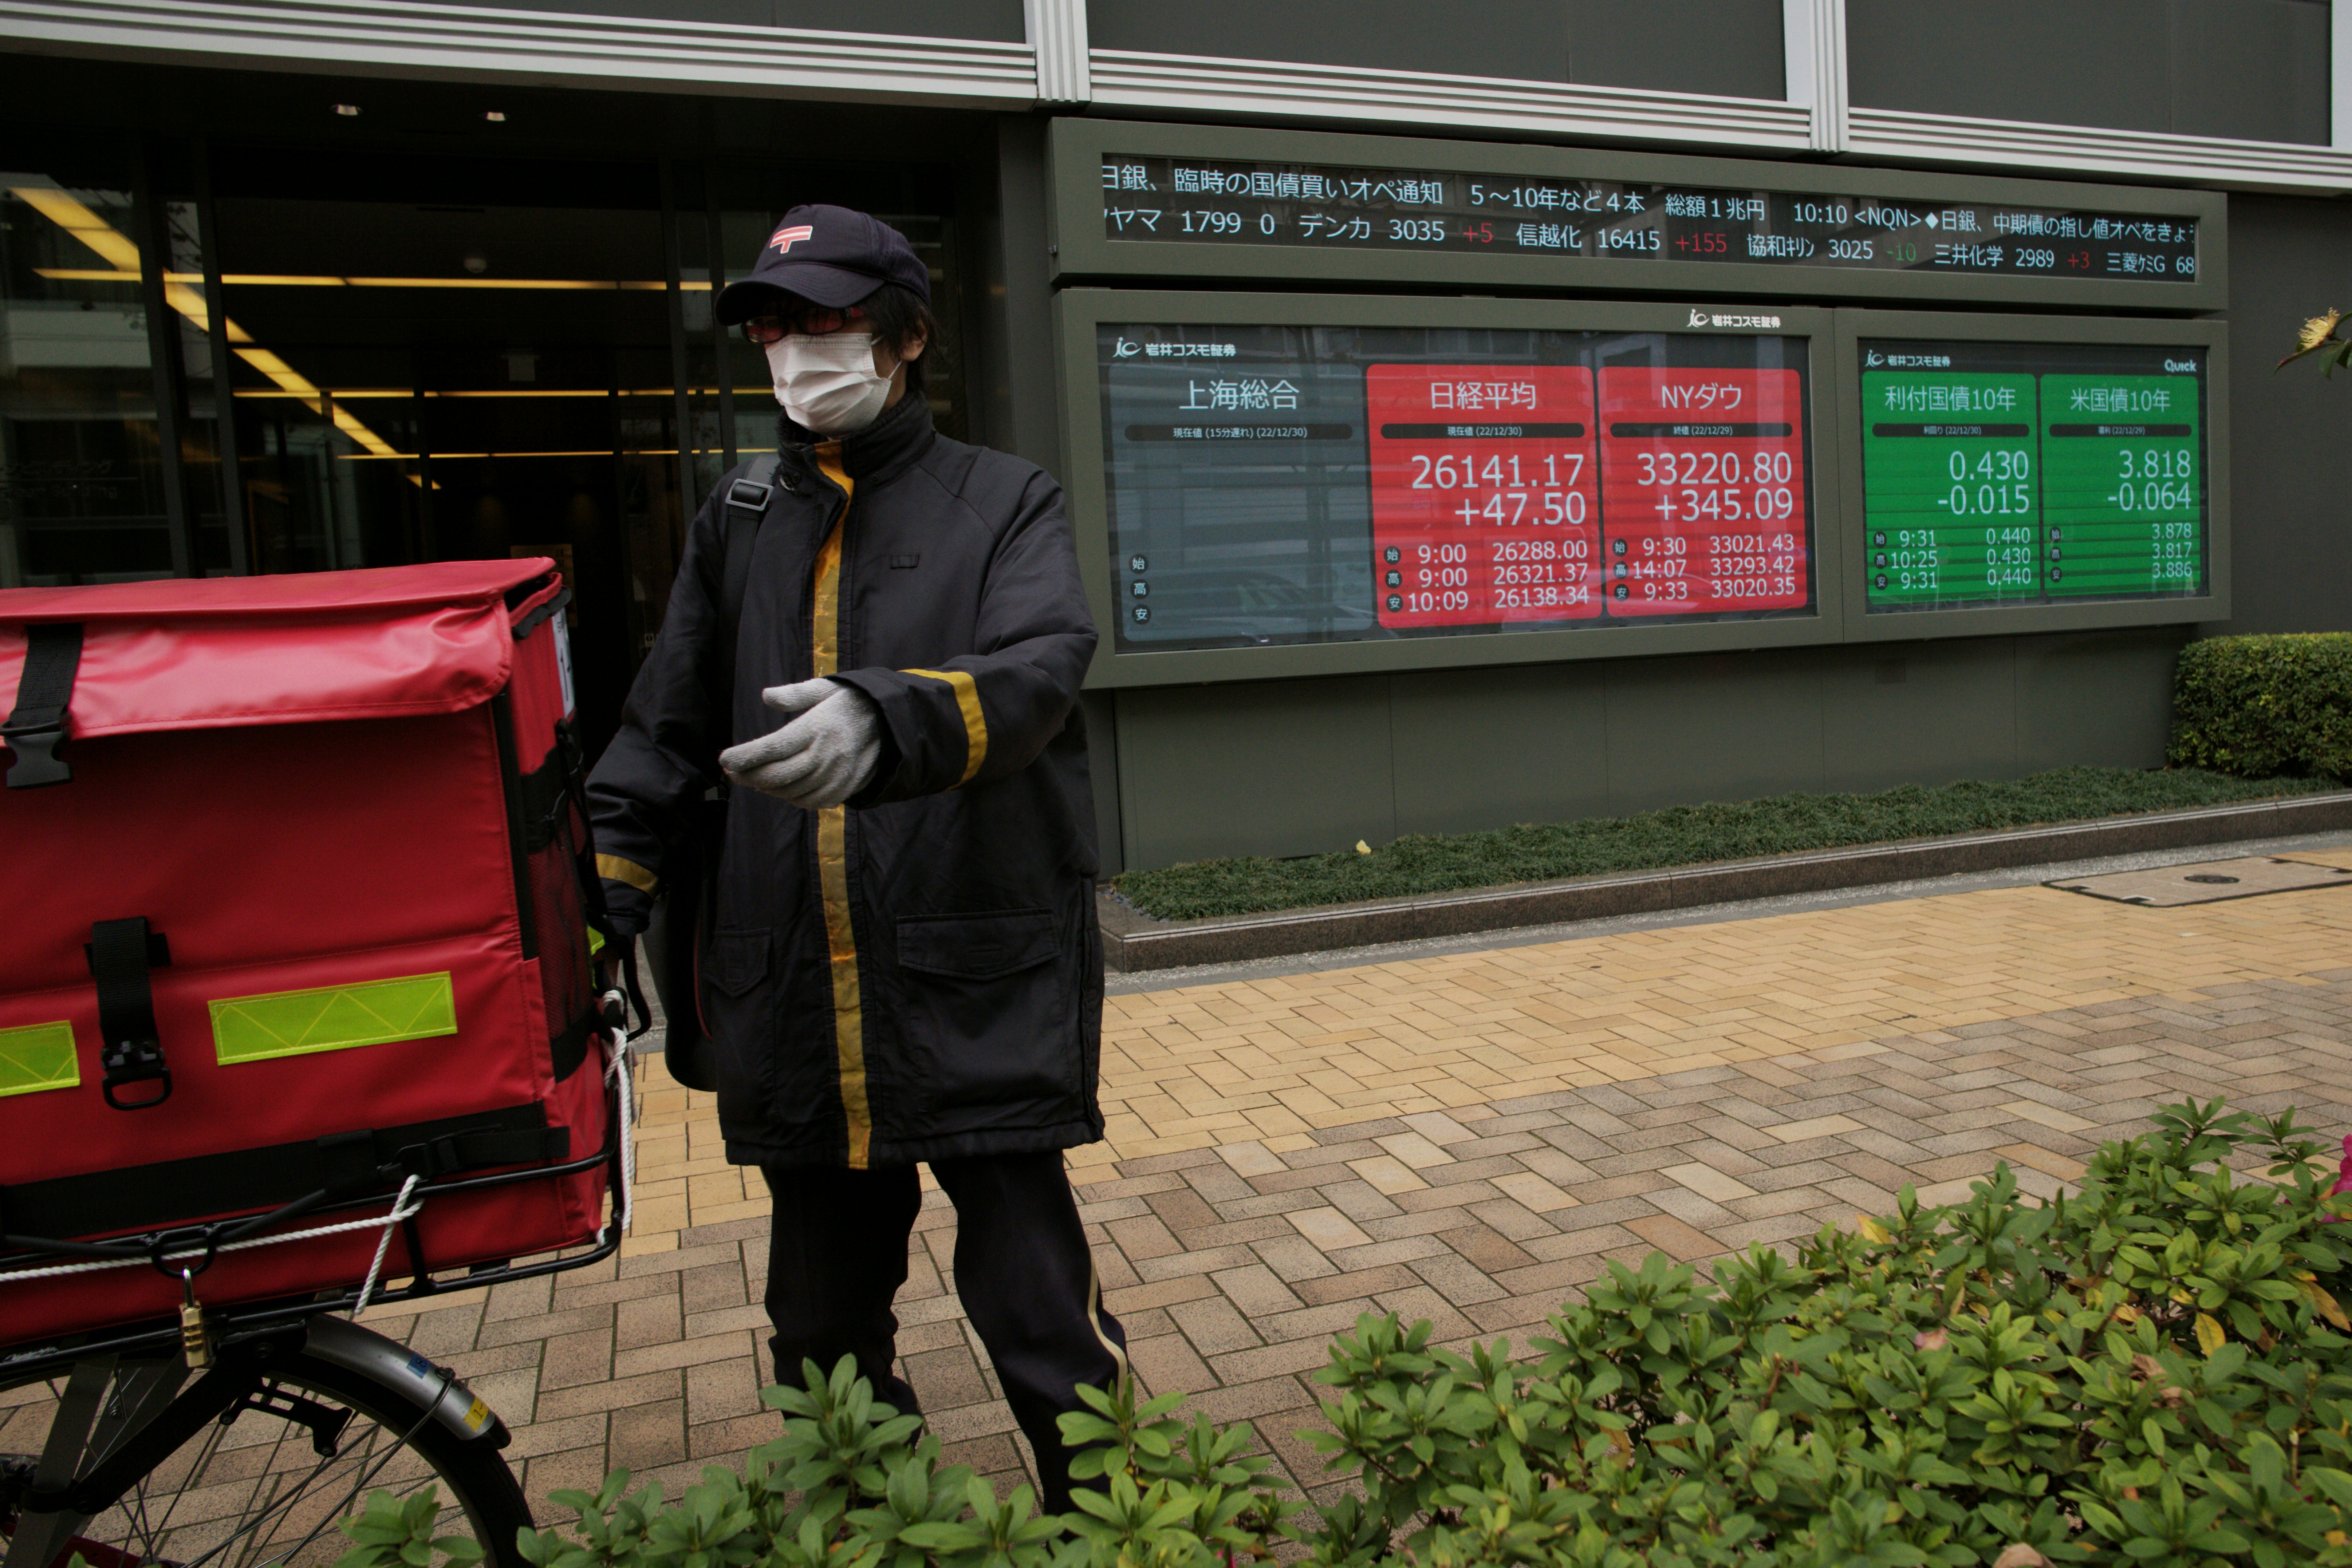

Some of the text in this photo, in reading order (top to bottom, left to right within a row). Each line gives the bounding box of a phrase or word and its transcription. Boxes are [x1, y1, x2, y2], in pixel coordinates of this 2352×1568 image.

[1794, 203, 1848, 224] 10:10
[1941, 210, 2194, 243] 日銀、中期債の指し値オペをきょ
[1104, 206, 1162, 232] ヤマ
[1181, 210, 1241, 233] 1799
[1260, 213, 1275, 234] 0
[1299, 213, 1370, 238] デンカ
[1390, 219, 1445, 241] 3035
[1463, 222, 1493, 243] +5
[1516, 223, 1582, 248] 信越化
[1598, 228, 1660, 250] 16415
[1675, 233, 1727, 253] +155
[1829, 239, 1874, 259] 3025
[1886, 243, 1916, 261] -10
[1935, 243, 2004, 266] 三井化学
[2016, 248, 2054, 267] 2989
[2067, 251, 2090, 269] +3
[2176, 256, 2194, 274] 68
[1712, 315, 1781, 328] 岩井コスモ証券
[1145, 343, 1236, 356] 岩井コスモ証券
[1888, 355, 1951, 367] 岩井コスモ証券
[1179, 379, 1299, 410] 上海総合
[1431, 381, 1536, 410] 日経平均
[1661, 382, 1741, 410] NYダウ
[1885, 386, 2016, 411] 利付国債10年
[2071, 387, 2171, 412] 米国債10年
[1173, 427, 1307, 439] 現在値 (15分遅れ) (22/12/30)
[1448, 426, 1522, 437] 現在値 (22/12/30)
[1691, 426, 1733, 436] (22/12/29)
[1946, 426, 1982, 435] (22/12/30)
[1411, 454, 1584, 489] 26141.17
[1638, 451, 1792, 486] 33220.80
[1950, 450, 2029, 481] 0.430
[2120, 449, 2191, 478] 3.818
[1655, 487, 1793, 521] +345.09
[1938, 484, 2029, 515] -0.015
[2108, 481, 2192, 511] -0.064
[1455, 491, 1586, 526] +47.50
[1900, 529, 1937, 547] 9:31
[1986, 527, 2031, 545] 0.440
[2152, 522, 2192, 540] 3.878
[1387, 540, 1588, 564] 始 9:00 26288.00
[1615, 534, 1794, 556] 始 9:30 33021.43
[2153, 541, 2193, 559] 3.817
[1132, 557, 1145, 570] 始
[1616, 556, 1795, 579] 高 14:07 33293.42
[1891, 550, 1939, 569] 10:25
[1987, 547, 2031, 565] 0.430
[1388, 563, 1589, 588] 高 9:00 26321.37
[1901, 571, 1938, 589] 9:31
[1987, 567, 2031, 586] 0.440
[2152, 561, 2193, 582] 3.886
[1134, 582, 1146, 595] 高
[1389, 586, 1590, 612] 安 10:09 26138.34
[1617, 577, 1796, 602] 安 9:33 33020.35
[1135, 608, 1147, 620] 安
